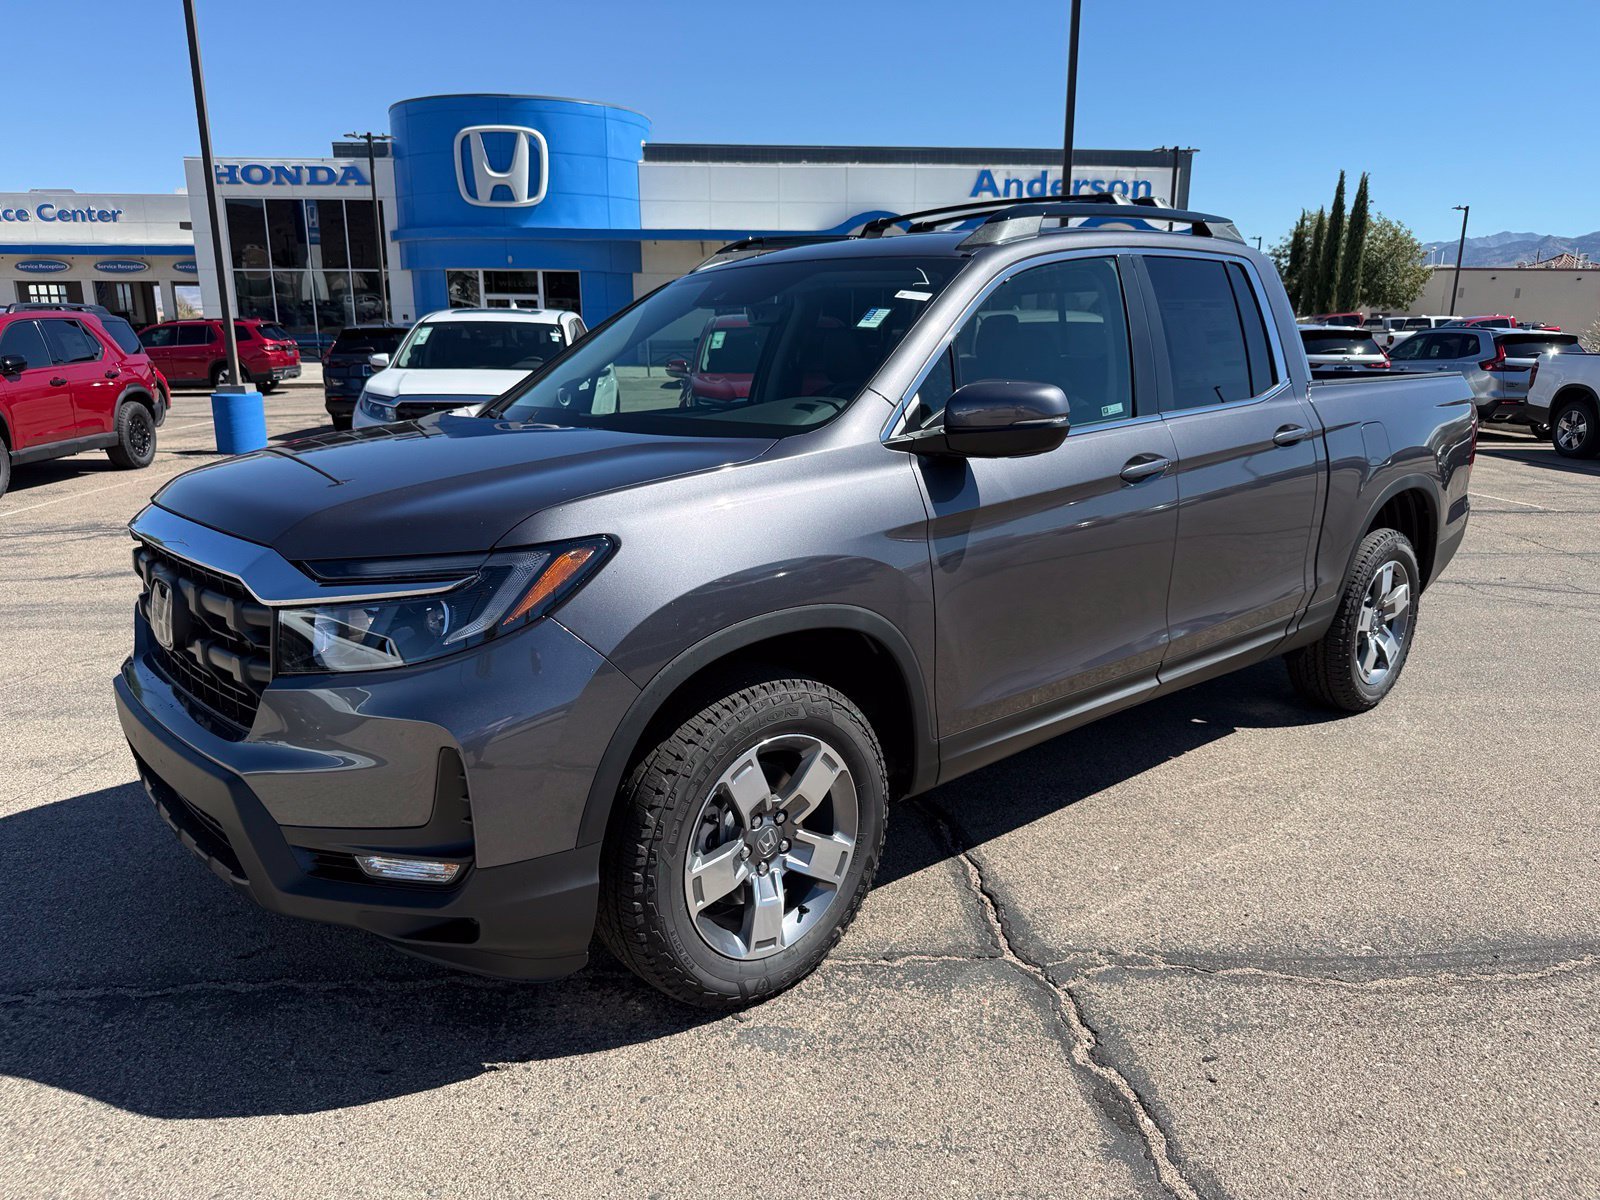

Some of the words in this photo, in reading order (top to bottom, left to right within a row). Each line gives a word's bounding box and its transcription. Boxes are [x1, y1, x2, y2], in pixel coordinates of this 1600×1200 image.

[215, 164, 371, 186] HONDA
[970, 169, 1152, 198] Anderson
[37, 204, 122, 222] Center
[39, 263, 66, 271] Reception
[118, 263, 145, 271] Reception
